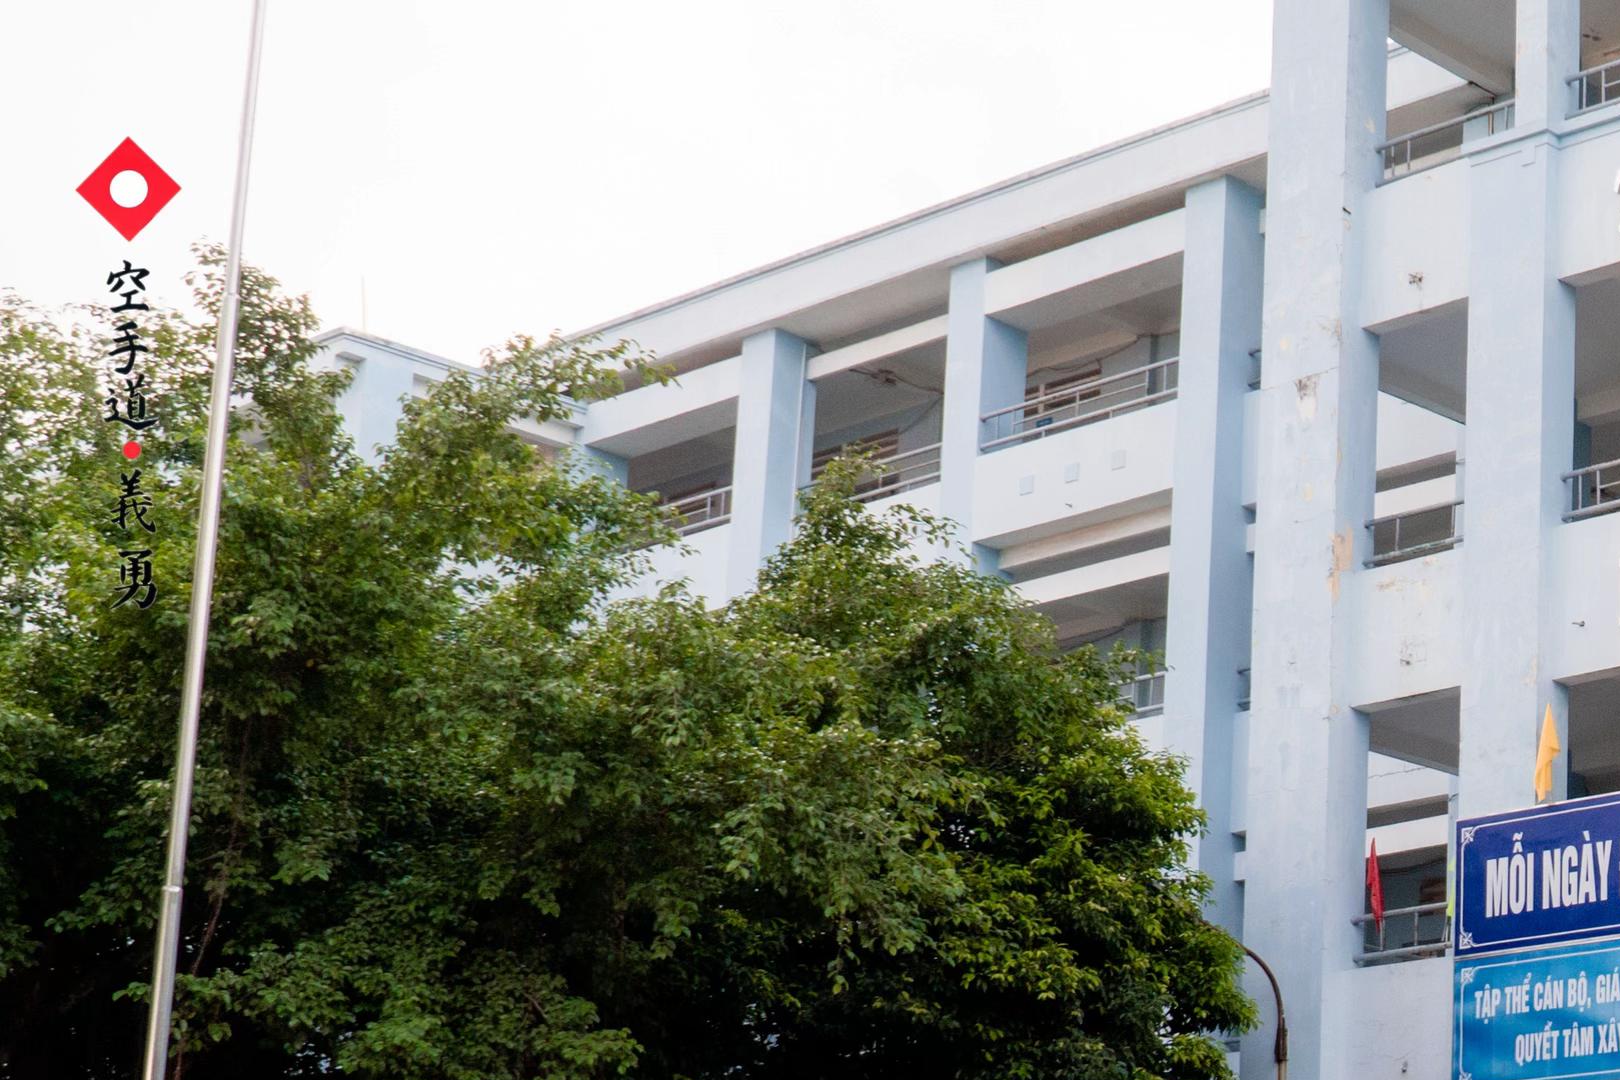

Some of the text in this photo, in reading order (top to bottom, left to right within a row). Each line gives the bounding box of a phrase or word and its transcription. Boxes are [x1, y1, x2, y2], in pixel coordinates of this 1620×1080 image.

[1485, 832, 1534, 918] MỖI
[1542, 830, 1613, 910] NGÀY
[1474, 984, 1501, 1024] TẬP
[1504, 972, 1532, 1015] THỂ
[1534, 975, 1564, 1011] CÁN
[1567, 971, 1592, 1013] BỘ,
[1515, 1020, 1559, 1066] QUYẾT
[1563, 1021, 1594, 1058] TÂM
